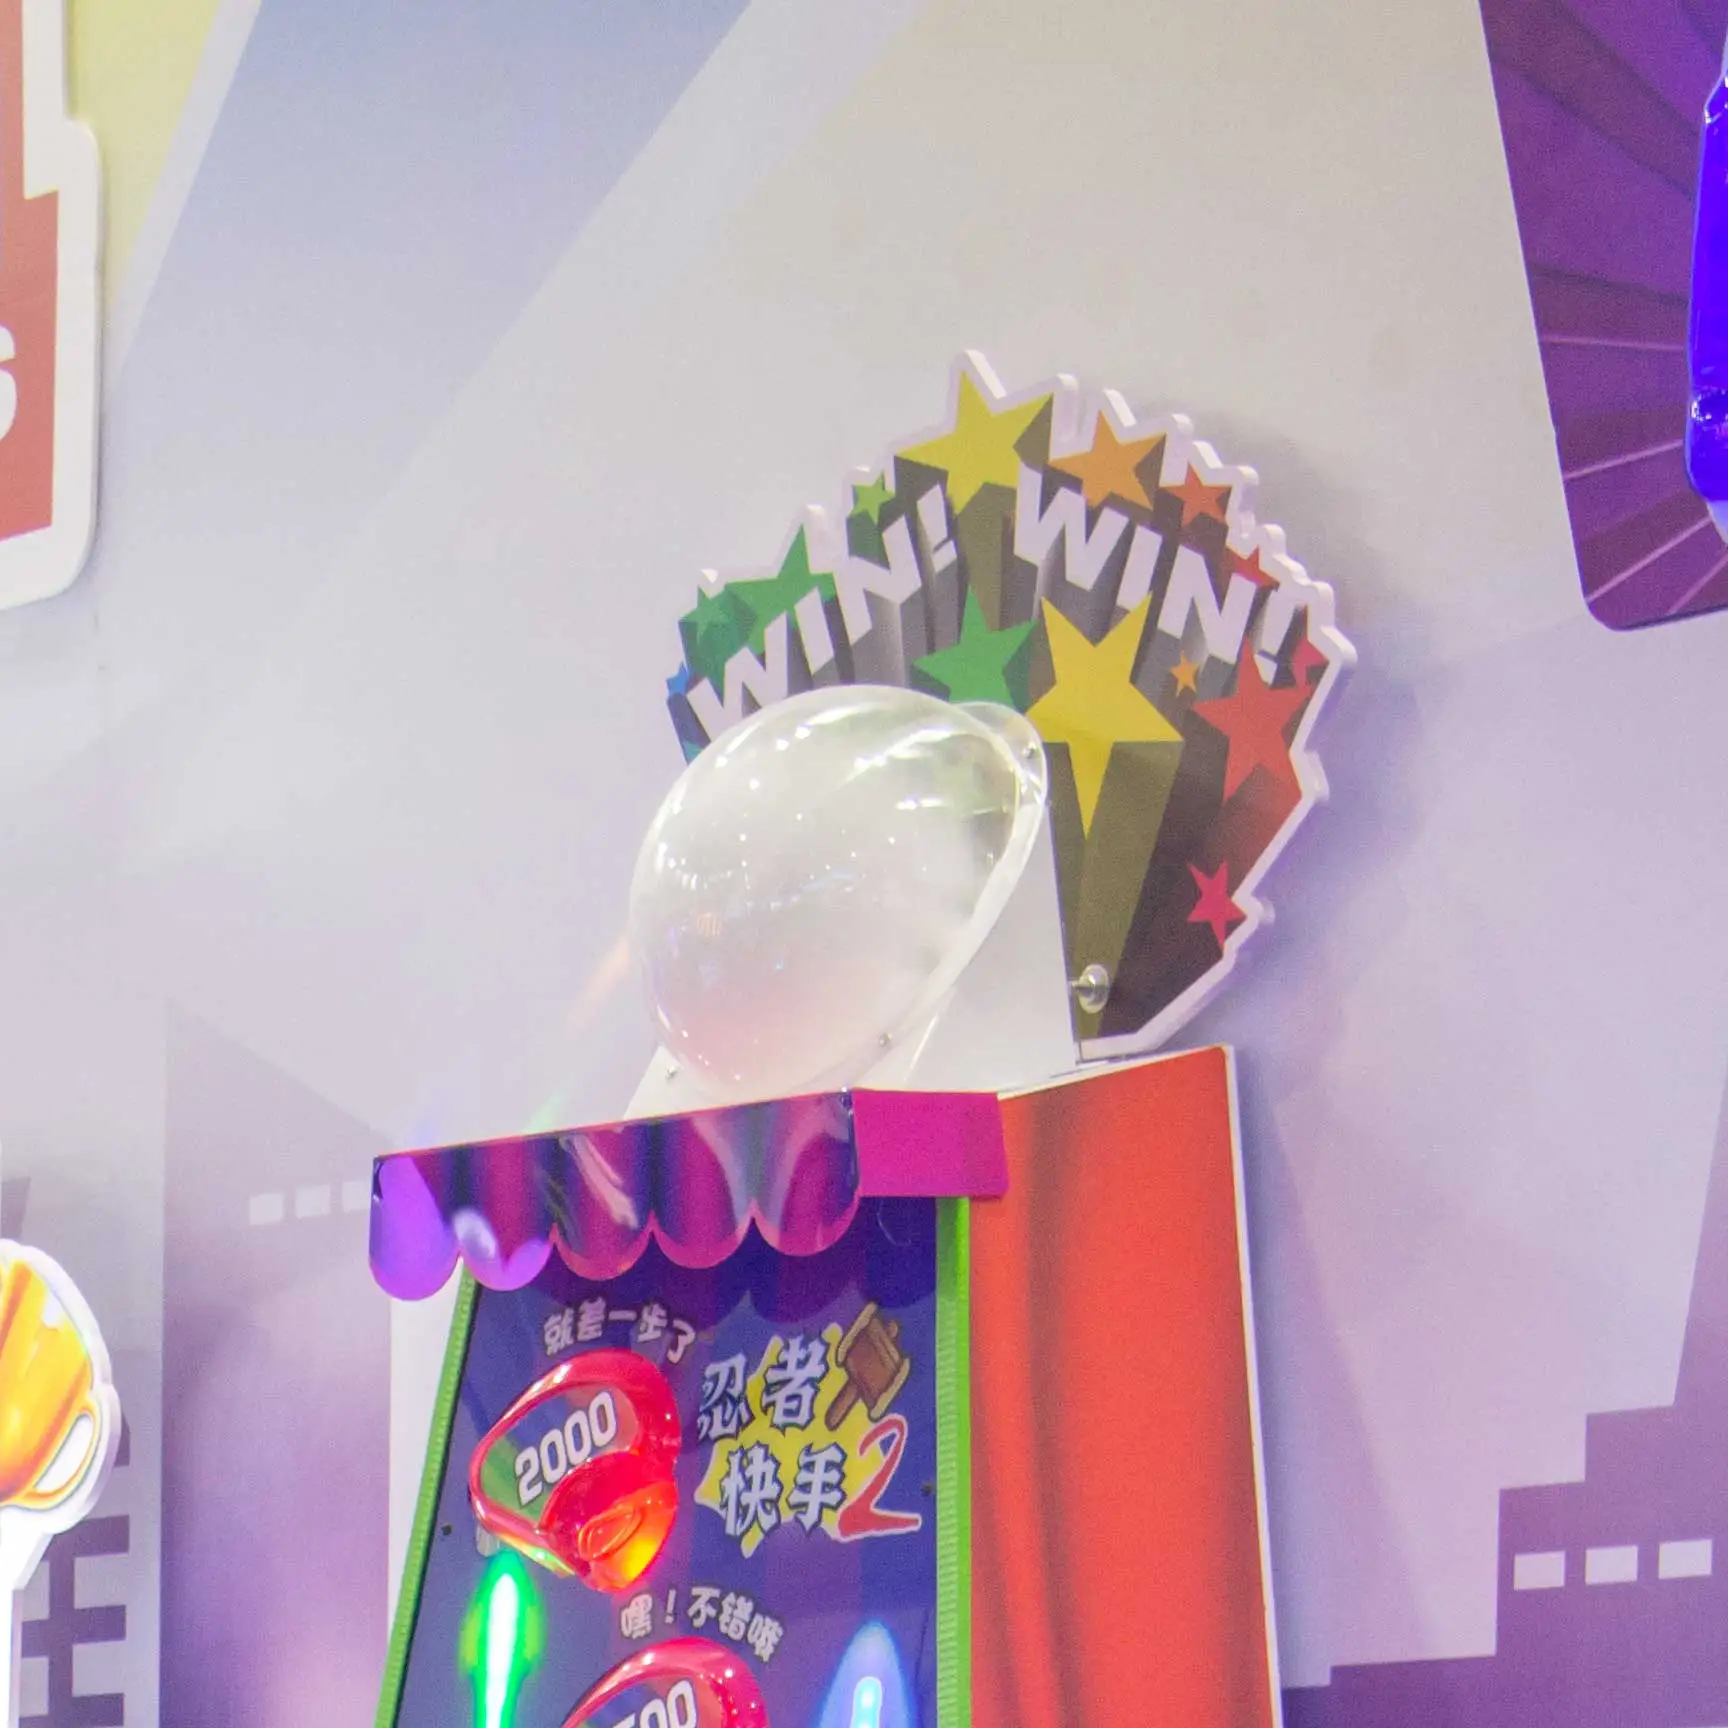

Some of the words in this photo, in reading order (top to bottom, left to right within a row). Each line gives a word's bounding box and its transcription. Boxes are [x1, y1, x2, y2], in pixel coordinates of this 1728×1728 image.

[686, 483, 958, 738] WIN!
[1013, 460, 1312, 685] WIN!
[696, 1335, 832, 1442] 忍者
[514, 1389, 617, 1508] 2000
